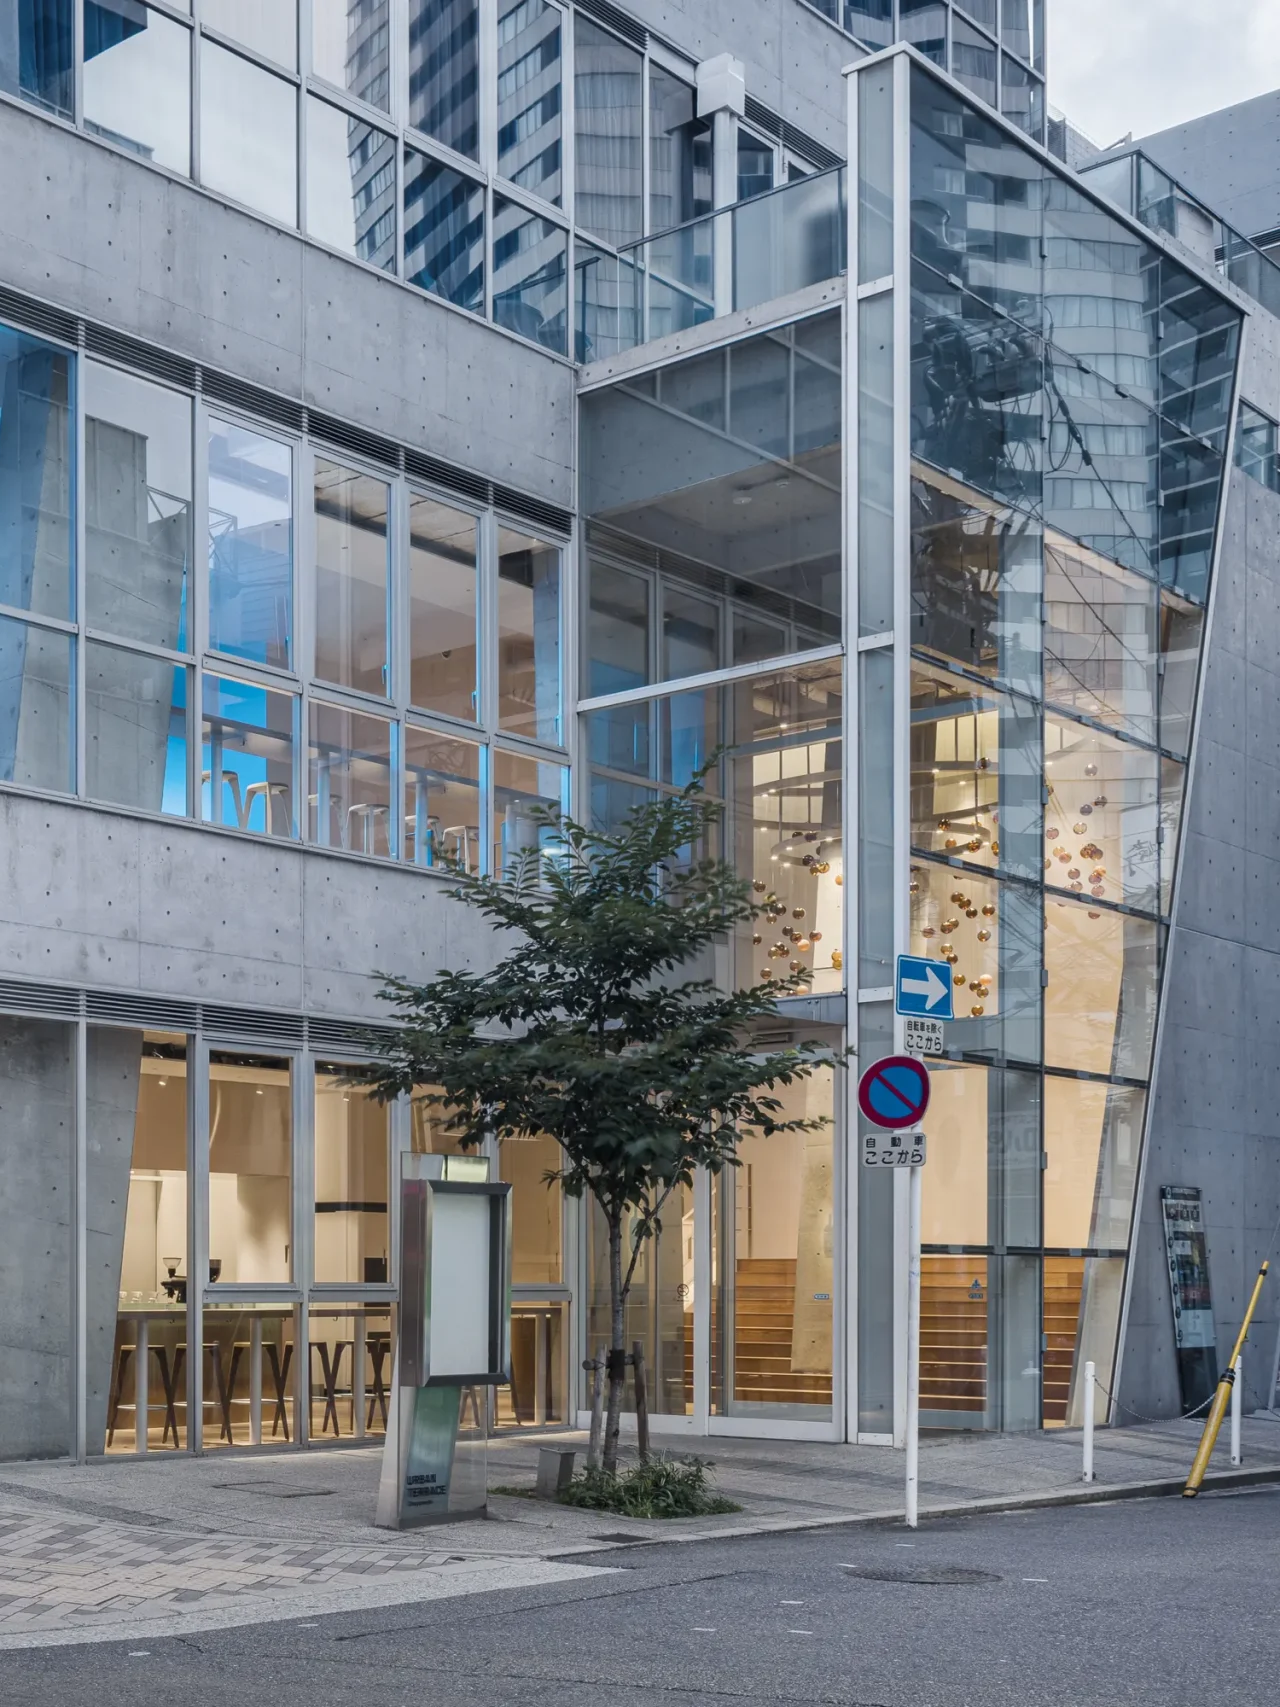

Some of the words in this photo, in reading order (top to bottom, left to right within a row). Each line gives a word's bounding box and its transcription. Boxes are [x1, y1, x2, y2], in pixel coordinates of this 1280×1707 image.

[907, 1020, 942, 1034] 自転車を除く
[906, 1034, 942, 1051] ここから
[865, 1135, 924, 1149] 自動車
[865, 1149, 923, 1165] ここから
